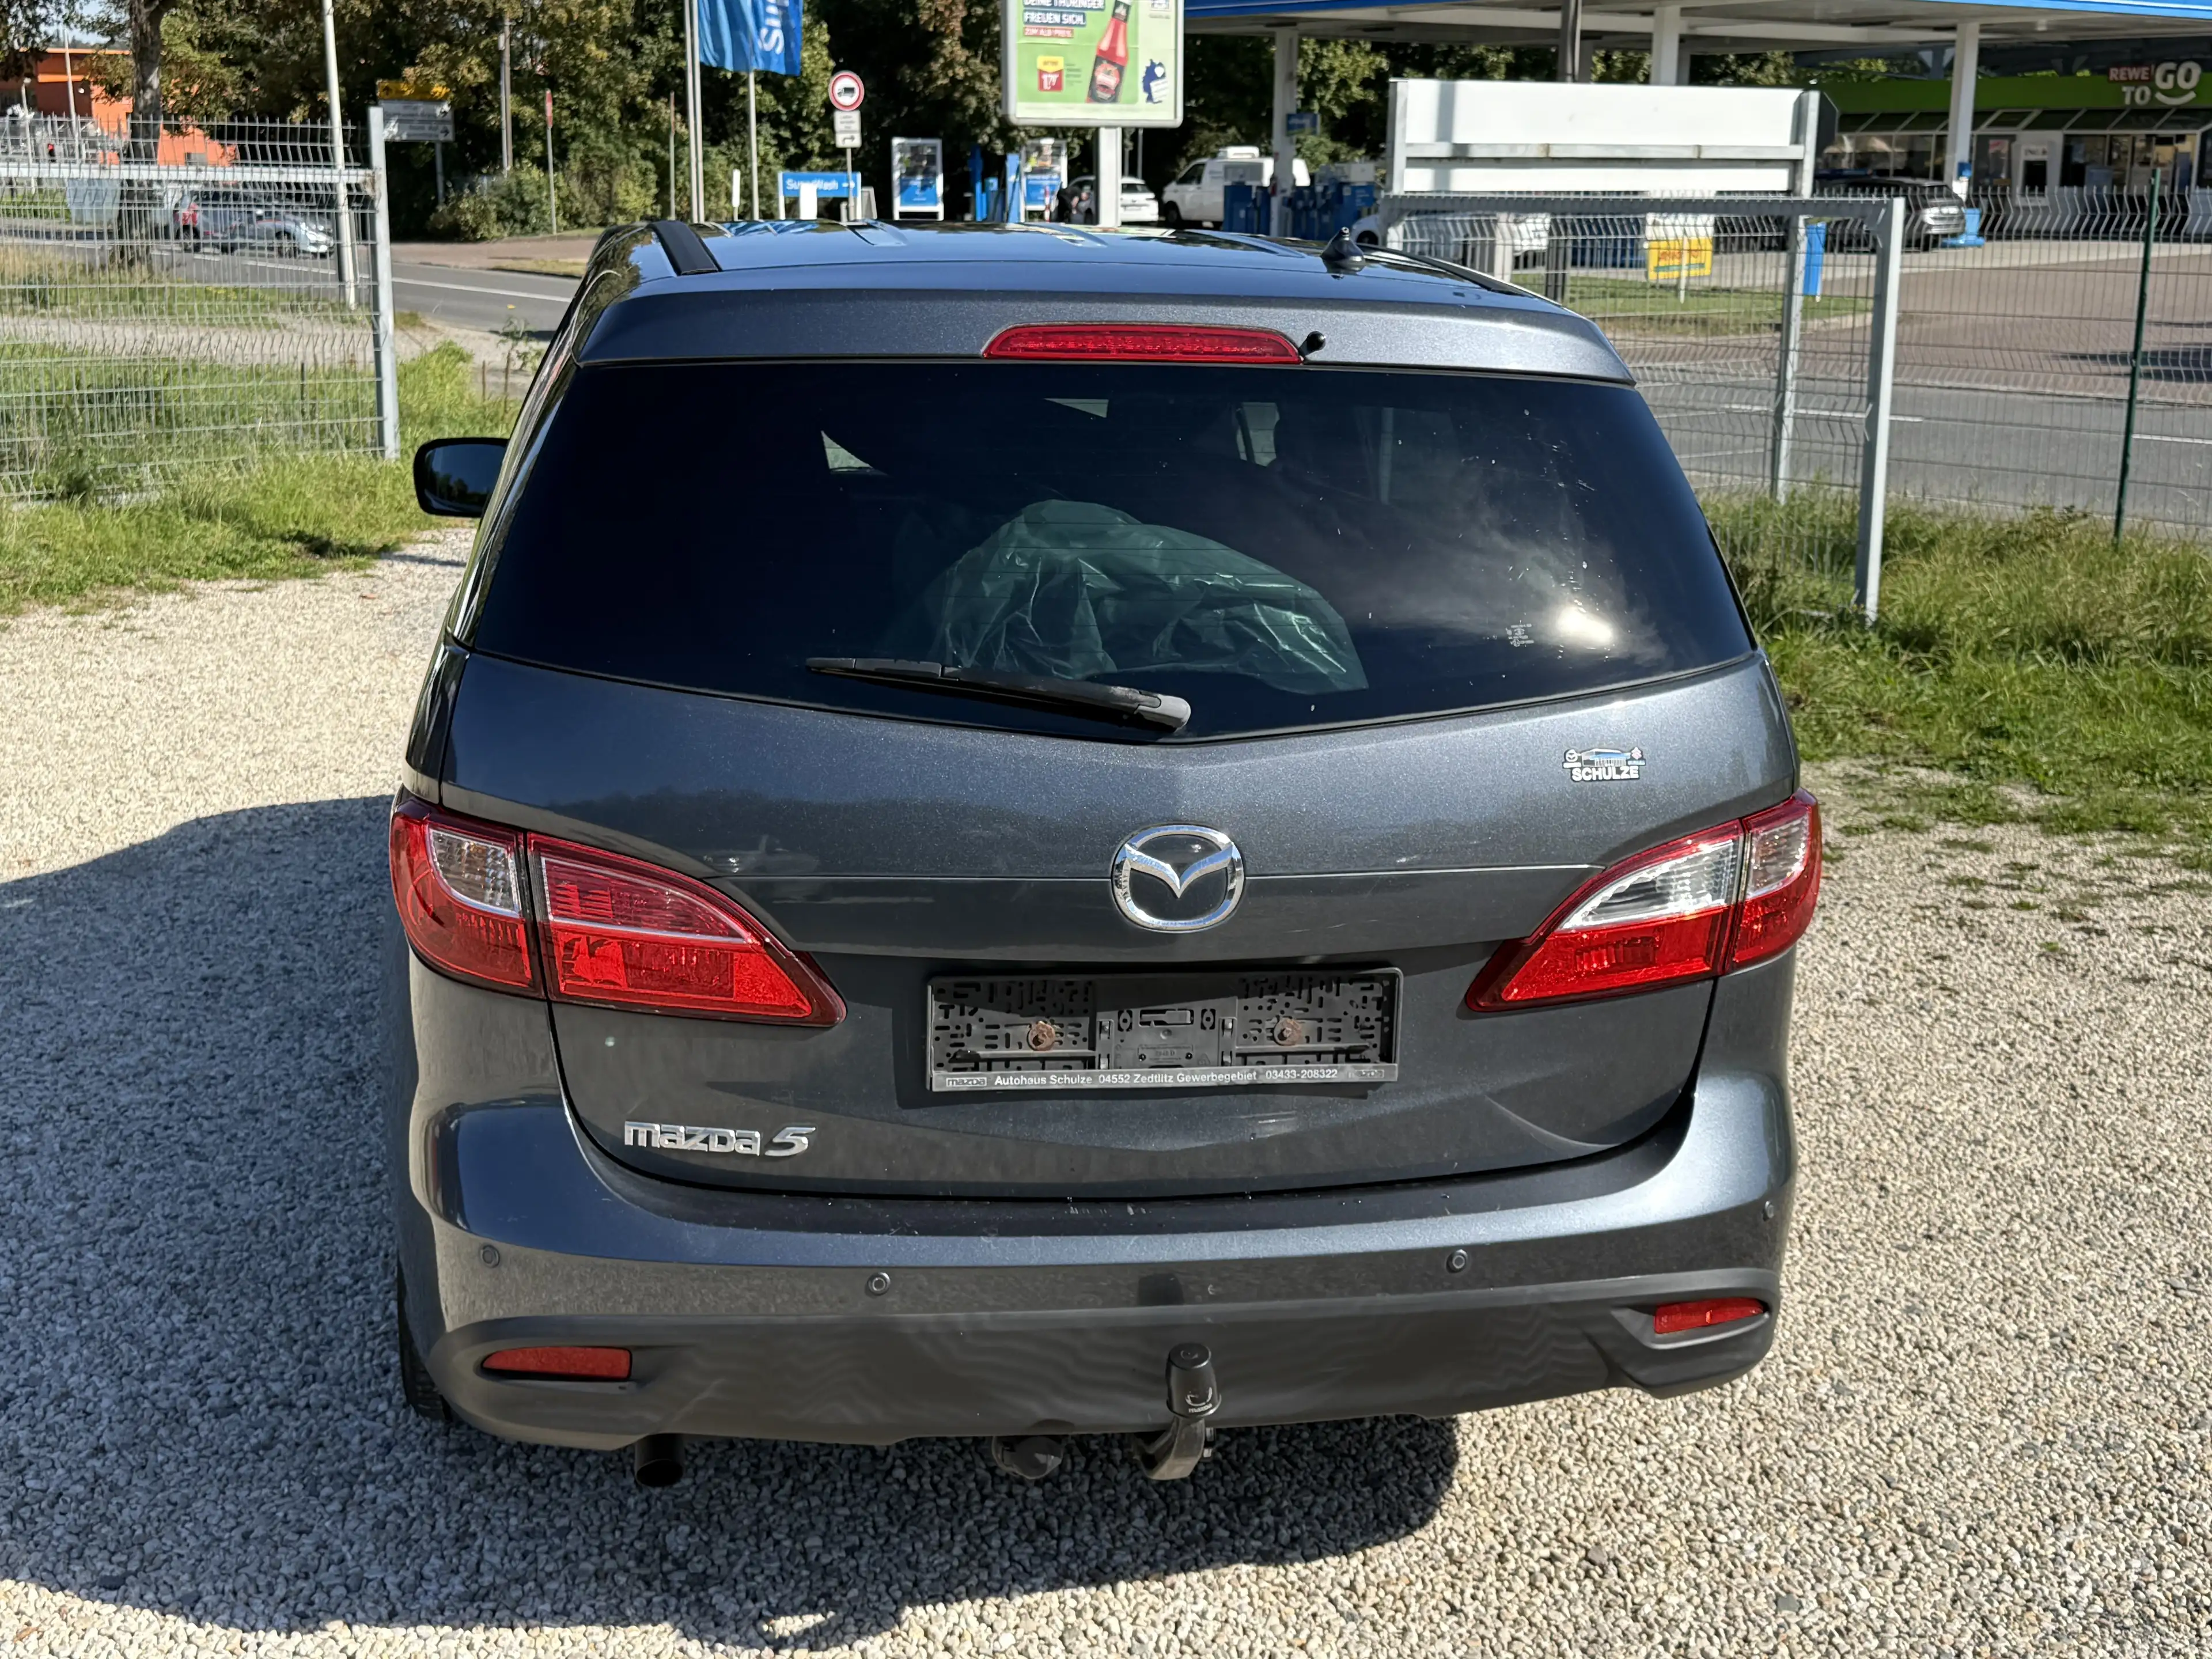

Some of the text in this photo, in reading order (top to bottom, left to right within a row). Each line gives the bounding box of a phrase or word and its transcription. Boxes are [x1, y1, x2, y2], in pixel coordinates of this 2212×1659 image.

[1024, 12, 1060, 24] FREUEN
[2109, 60, 2203, 106] REWE TO GO
[1571, 766, 1639, 782] SCHULZE
[994, 1075, 1047, 1085] Autohaus
[1050, 1074, 1093, 1085] Schulze
[1099, 1074, 1130, 1084] 04552
[1133, 1073, 1174, 1084] Zedtlitz
[1176, 1071, 1257, 1083] Gewerbegebiet
[1266, 1069, 1338, 1080] 03433-208322
[624, 1120, 816, 1157] mazda 5
